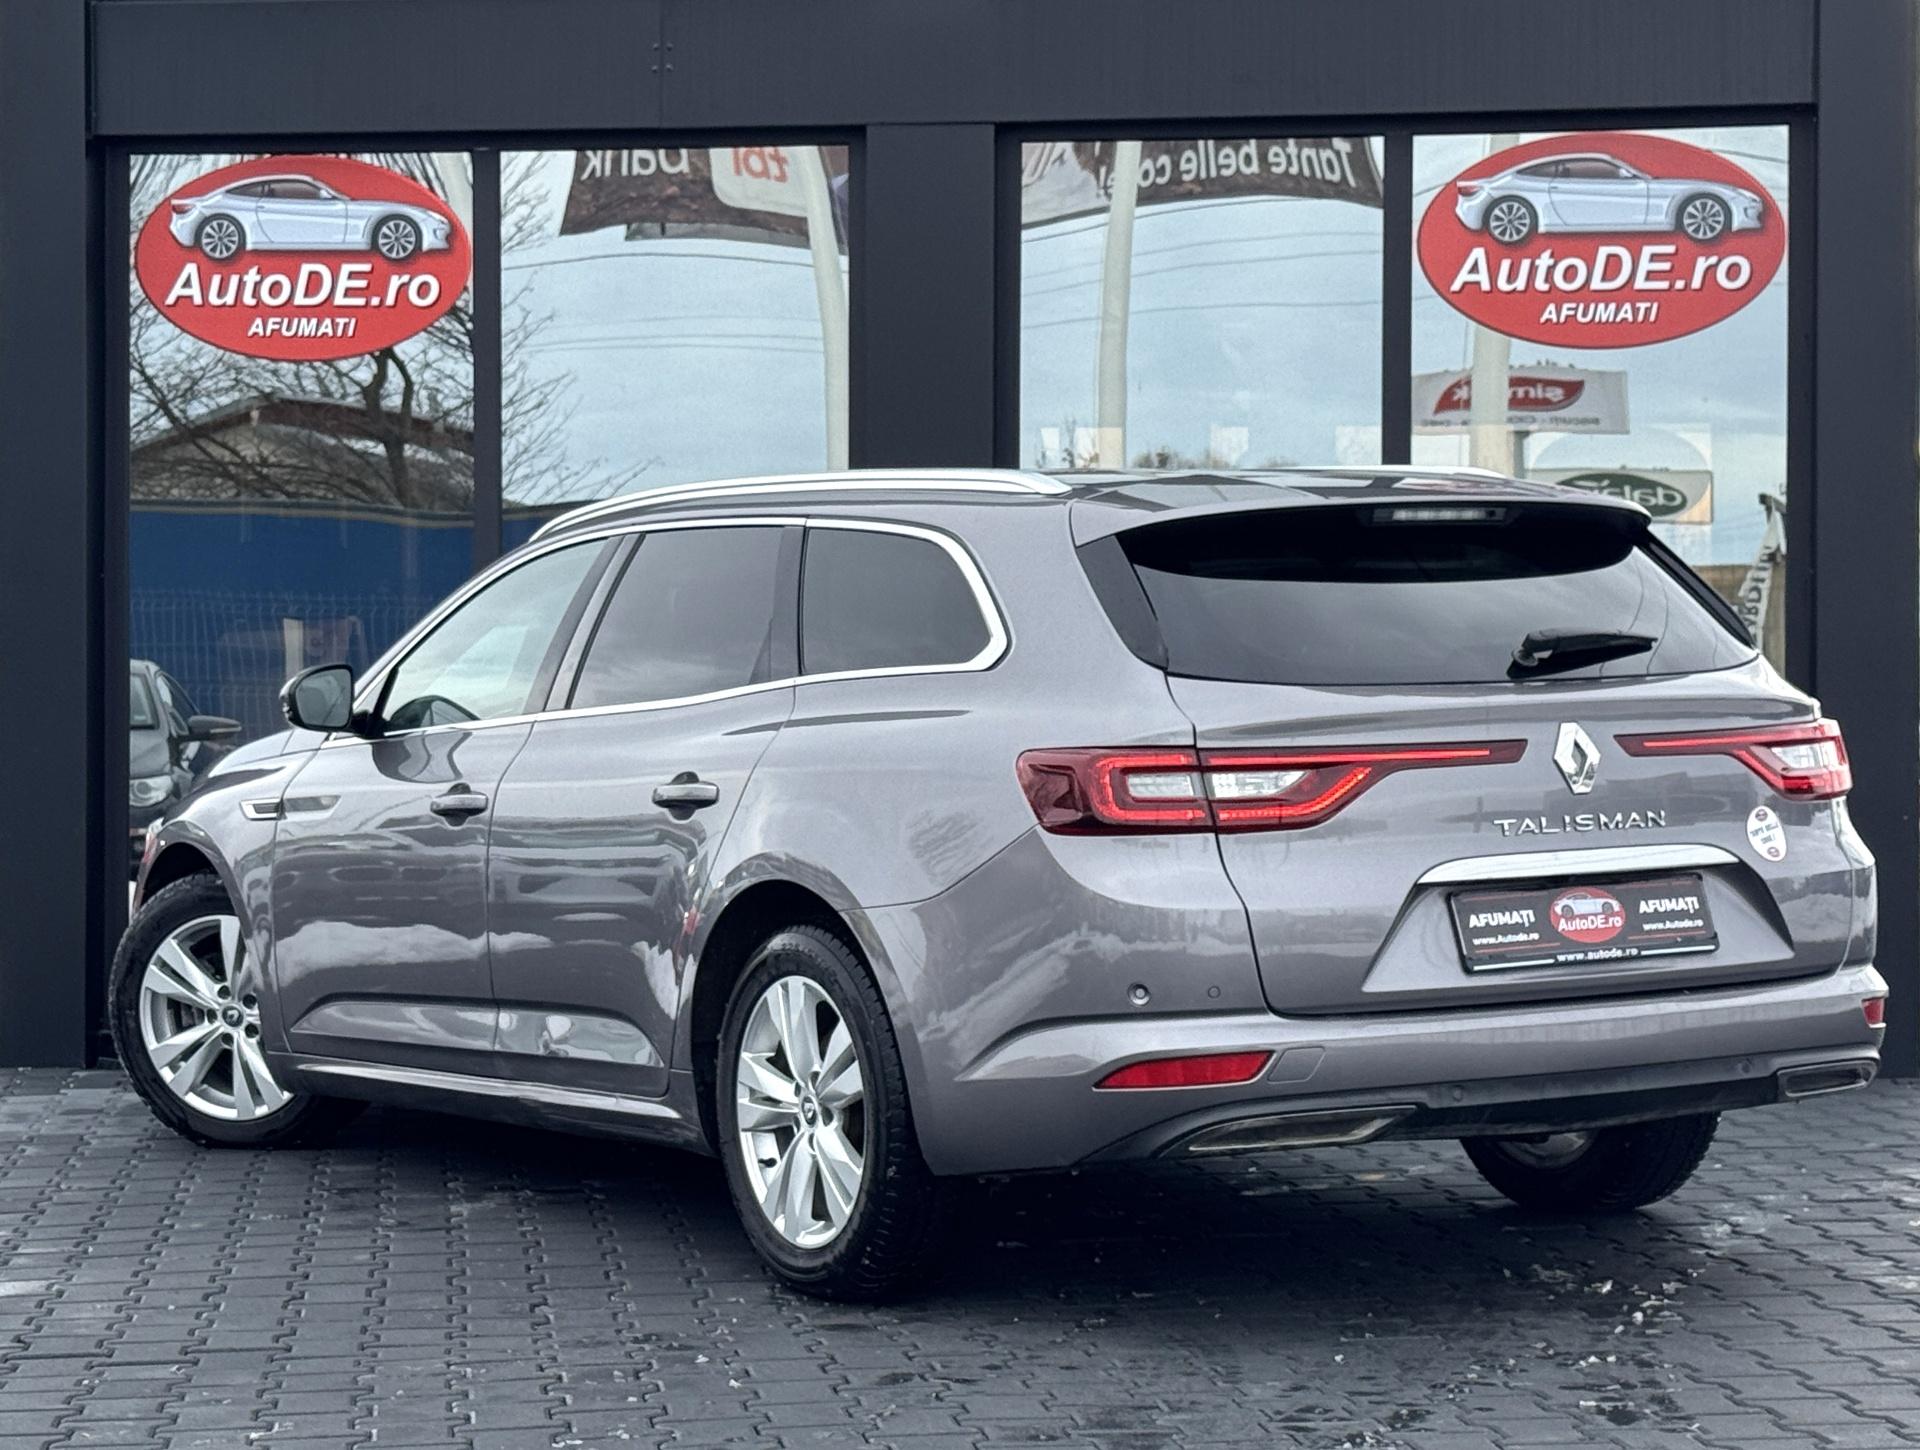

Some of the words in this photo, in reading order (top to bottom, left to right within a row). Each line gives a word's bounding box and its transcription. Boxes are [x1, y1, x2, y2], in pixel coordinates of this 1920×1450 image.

[1450, 244, 1752, 293] AutoDE.ro
[164, 262, 441, 308] AutoDE.ro
[1539, 302, 1660, 324] AFUMATI
[247, 317, 357, 339] AFUMATI
[1493, 810, 1667, 837] TALISMAN
[1557, 914, 1623, 932] AutoDE.ro
[1556, 947, 1639, 962] www.autode.ro
